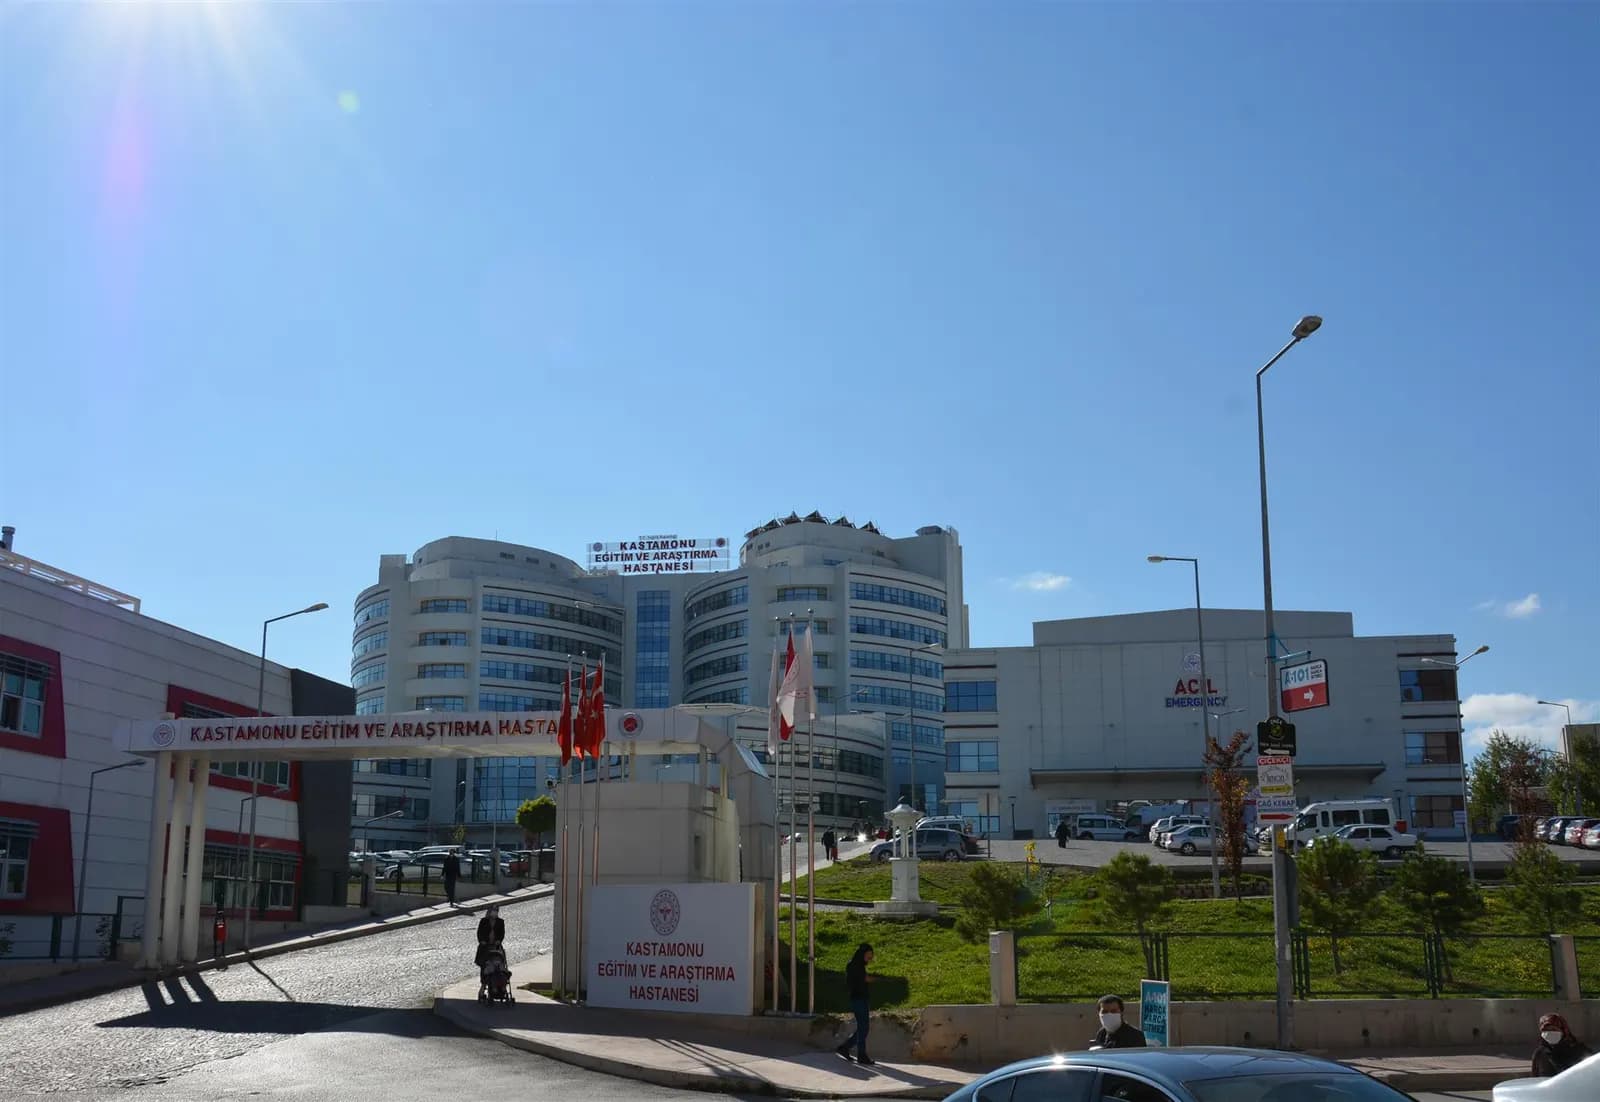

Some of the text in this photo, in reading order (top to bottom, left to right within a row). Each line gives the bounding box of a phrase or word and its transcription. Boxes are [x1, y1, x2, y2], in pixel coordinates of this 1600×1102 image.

[620, 539, 696, 551] KASTAMONU
[595, 549, 718, 563] EĞİTİM VE ARAŞTIRMA
[624, 560, 694, 573] HASTANESİ
[1175, 678, 1218, 695] ACL
[190, 717, 558, 742] KASTAMONU EĞİTİM VE ARAŞTIRMA HASTA
[626, 942, 704, 958] KASTAMONU
[598, 959, 736, 984] EĞİTİM VE ARAŞTIRMA
[629, 984, 700, 1003] HASTANESİ
